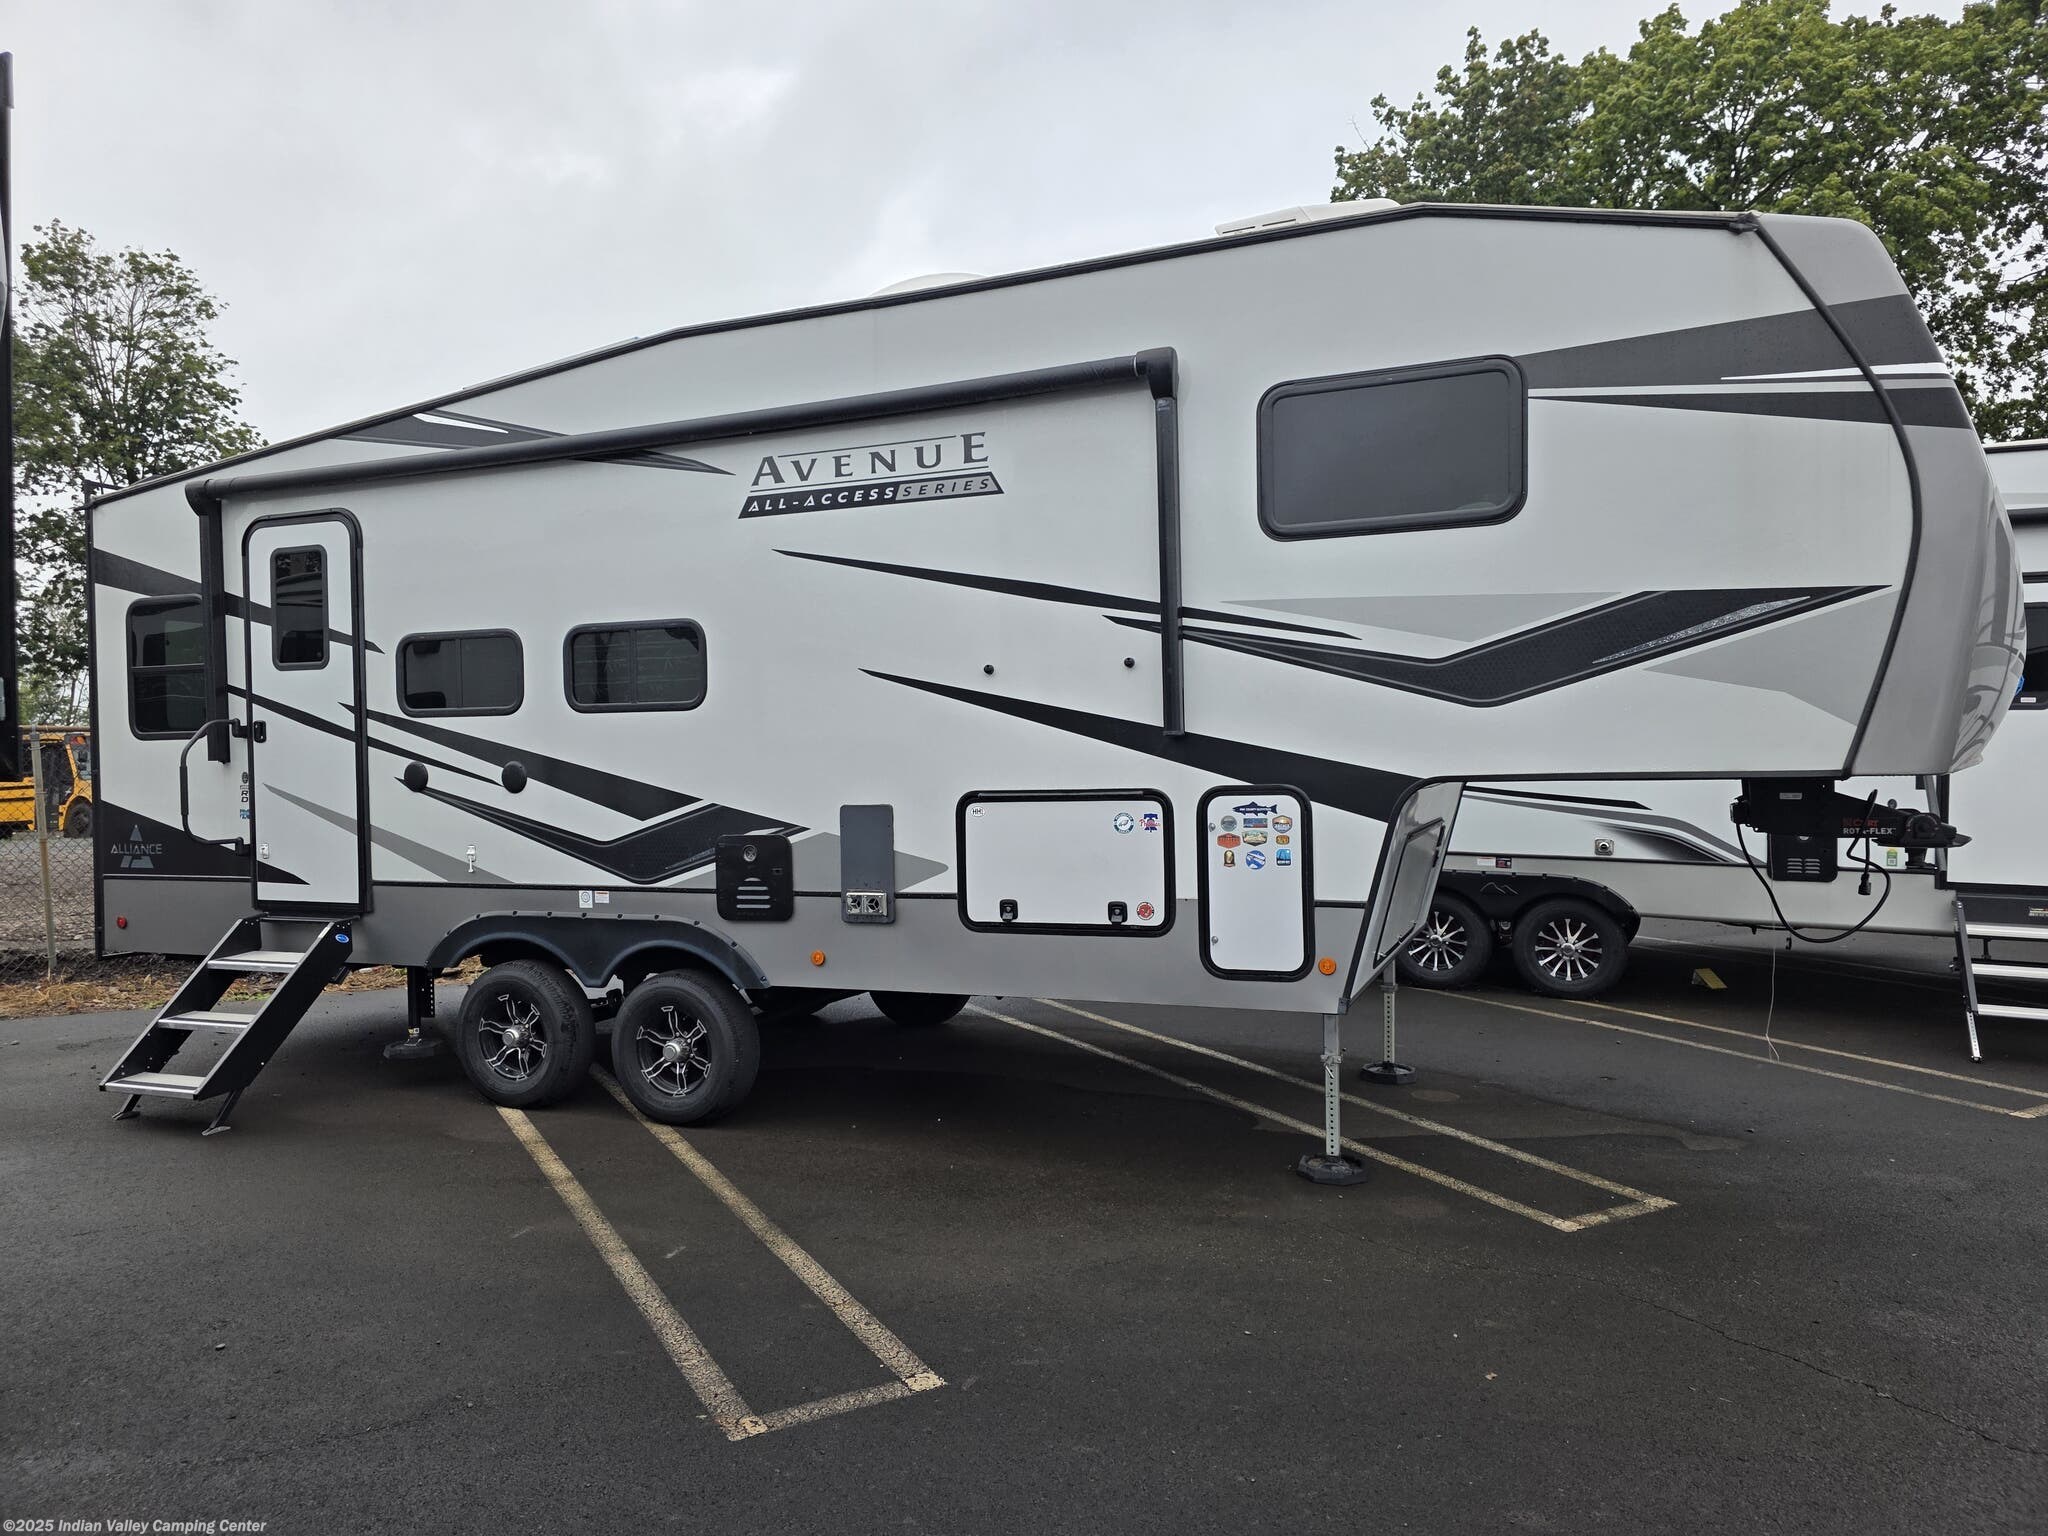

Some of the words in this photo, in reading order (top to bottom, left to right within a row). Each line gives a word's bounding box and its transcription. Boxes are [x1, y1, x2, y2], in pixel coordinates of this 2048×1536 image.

[751, 432, 989, 486] AVENUE
[748, 487, 894, 512] ALL-ACCESS
[903, 478, 990, 497] SERIES
[110, 843, 163, 855] ALLIANCE
